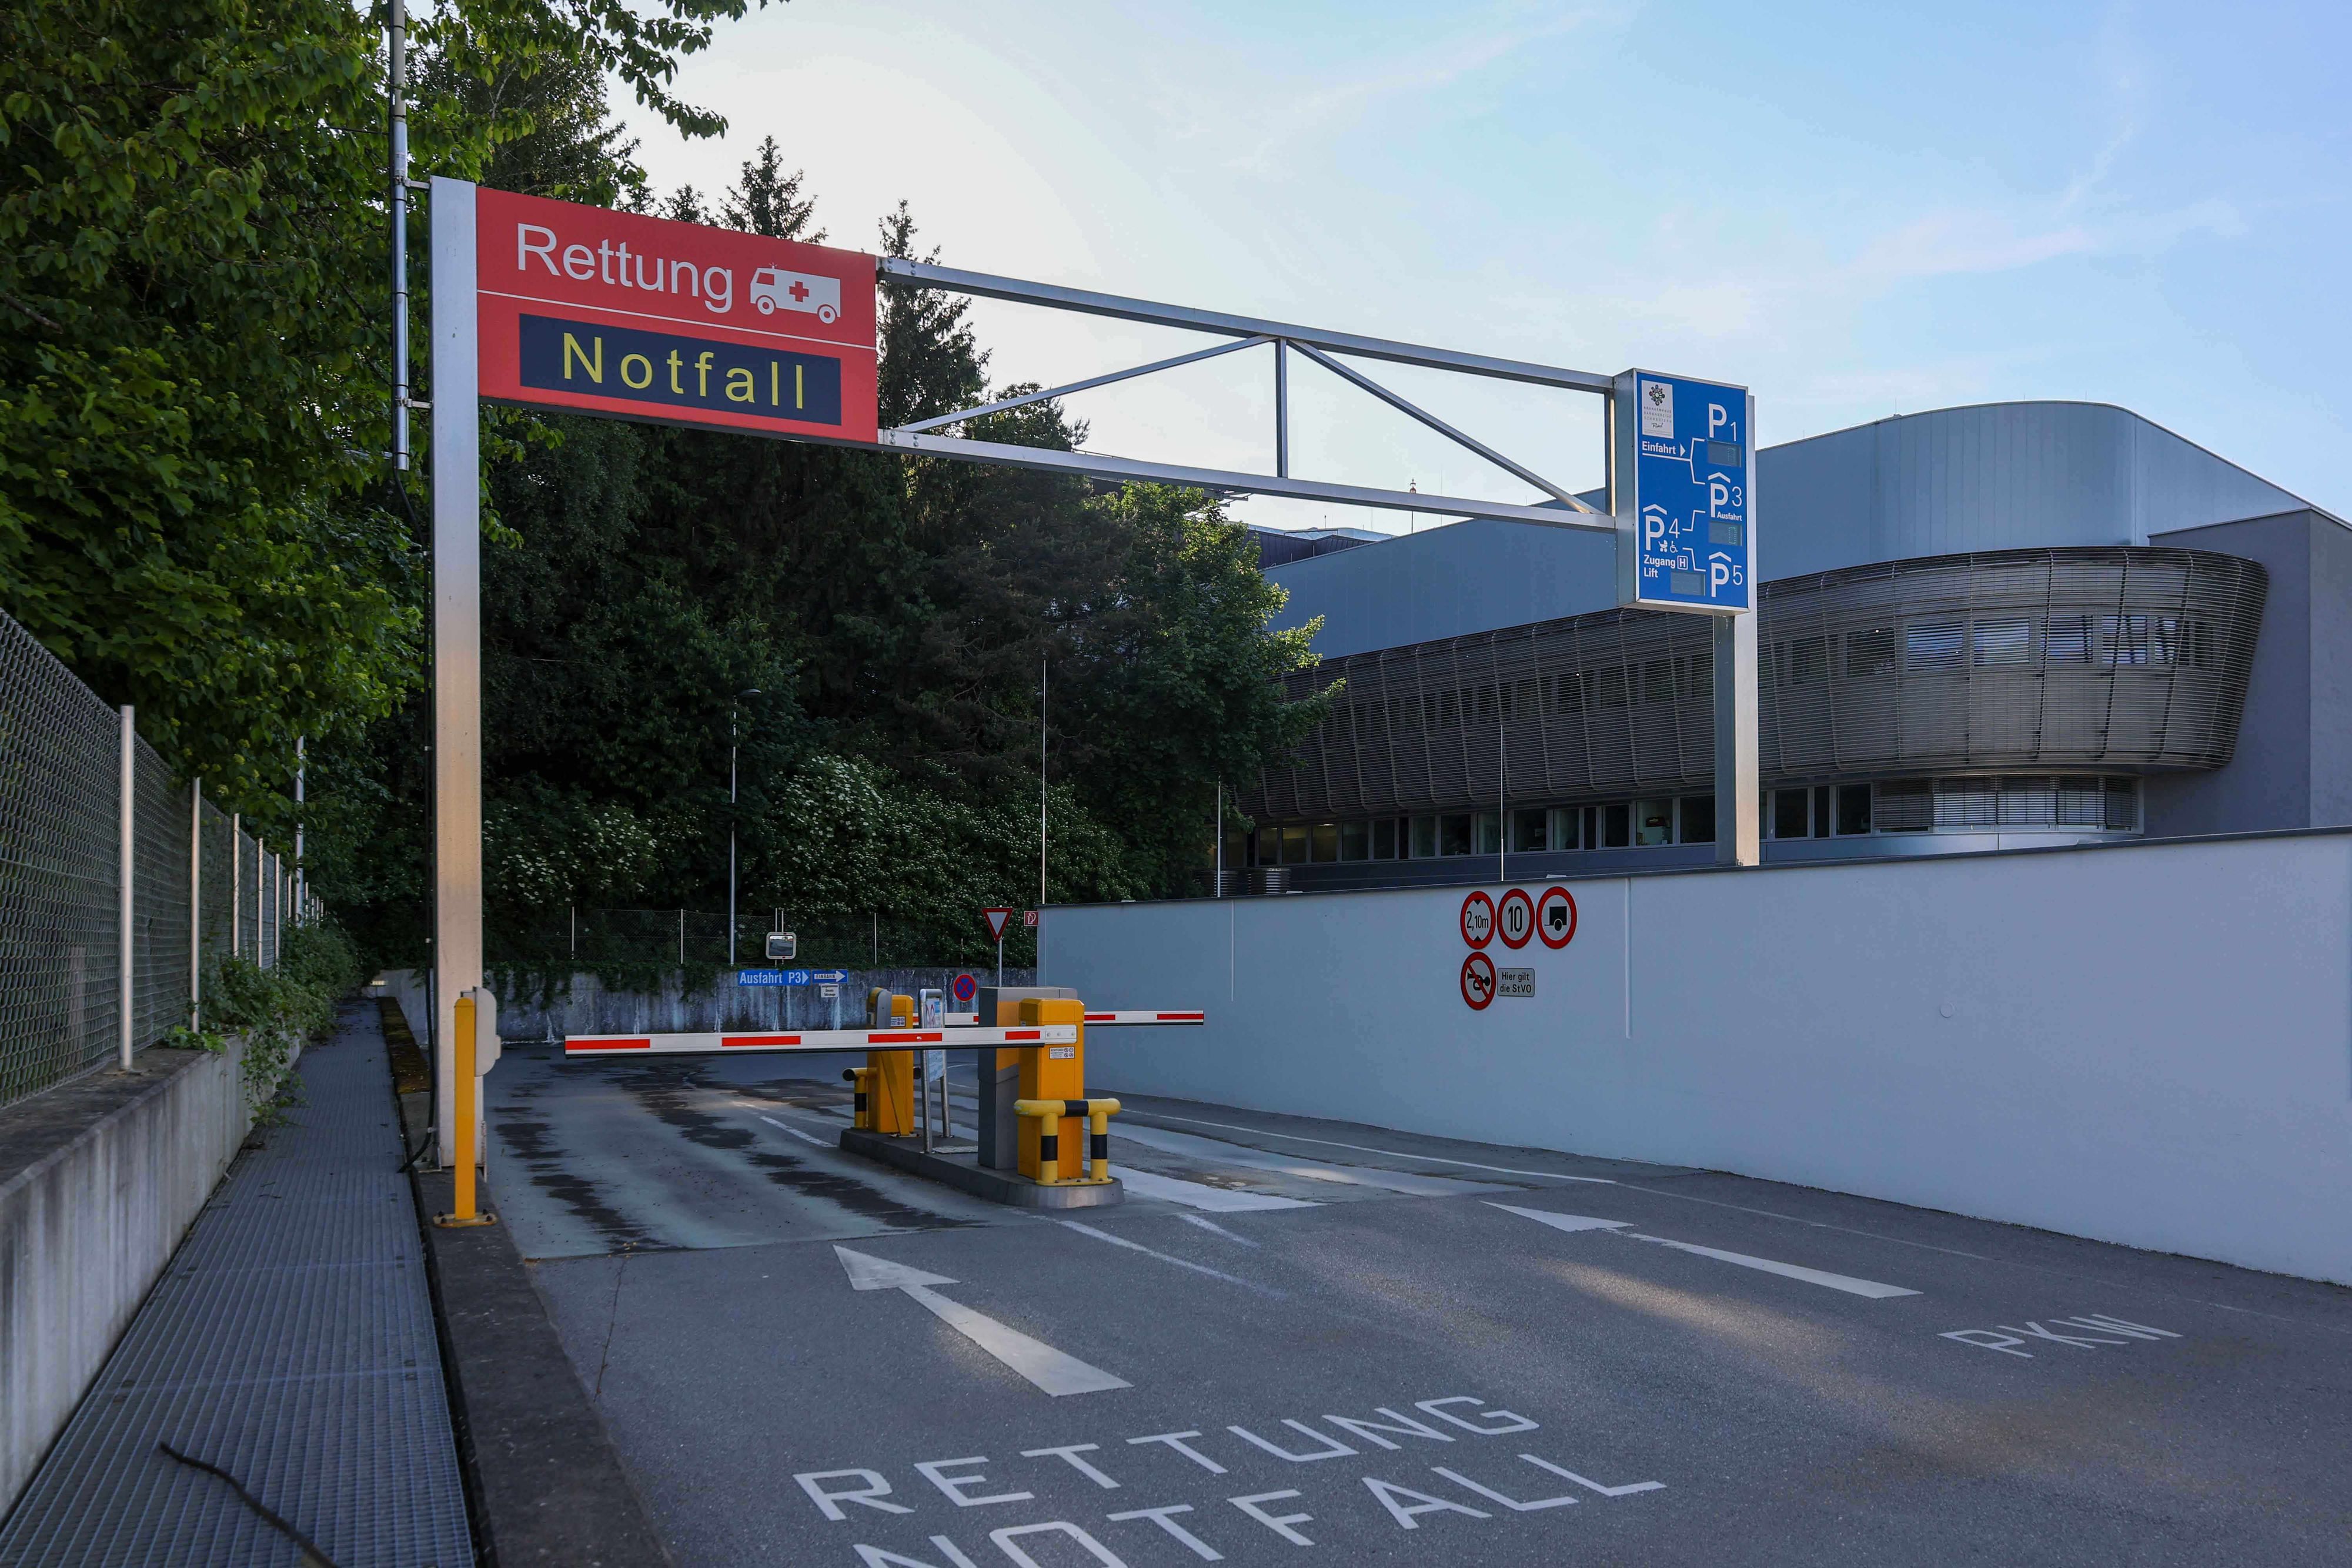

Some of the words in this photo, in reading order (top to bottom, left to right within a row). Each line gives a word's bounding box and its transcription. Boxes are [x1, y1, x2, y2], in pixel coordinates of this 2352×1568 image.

[517, 223, 733, 313] Rettung
[563, 332, 803, 410] Notfall
[1642, 441, 1676, 454] Einfahrt
[1717, 511, 1742, 521] Ausfahrt
[1643, 554, 1676, 569] Zugang
[1643, 567, 1658, 578] Lift
[1466, 911, 1489, 931] 2,10m
[1508, 905, 1523, 932] 10
[740, 972, 783, 984] Ausfahrt
[789, 972, 801, 984] P3
[1502, 972, 1515, 980] Hier
[1518, 972, 1529, 982] gilt
[1512, 984, 1531, 992] StVO
[1937, 1314, 2183, 1358] PKW
[793, 1395, 1539, 1521] RETTUNG
